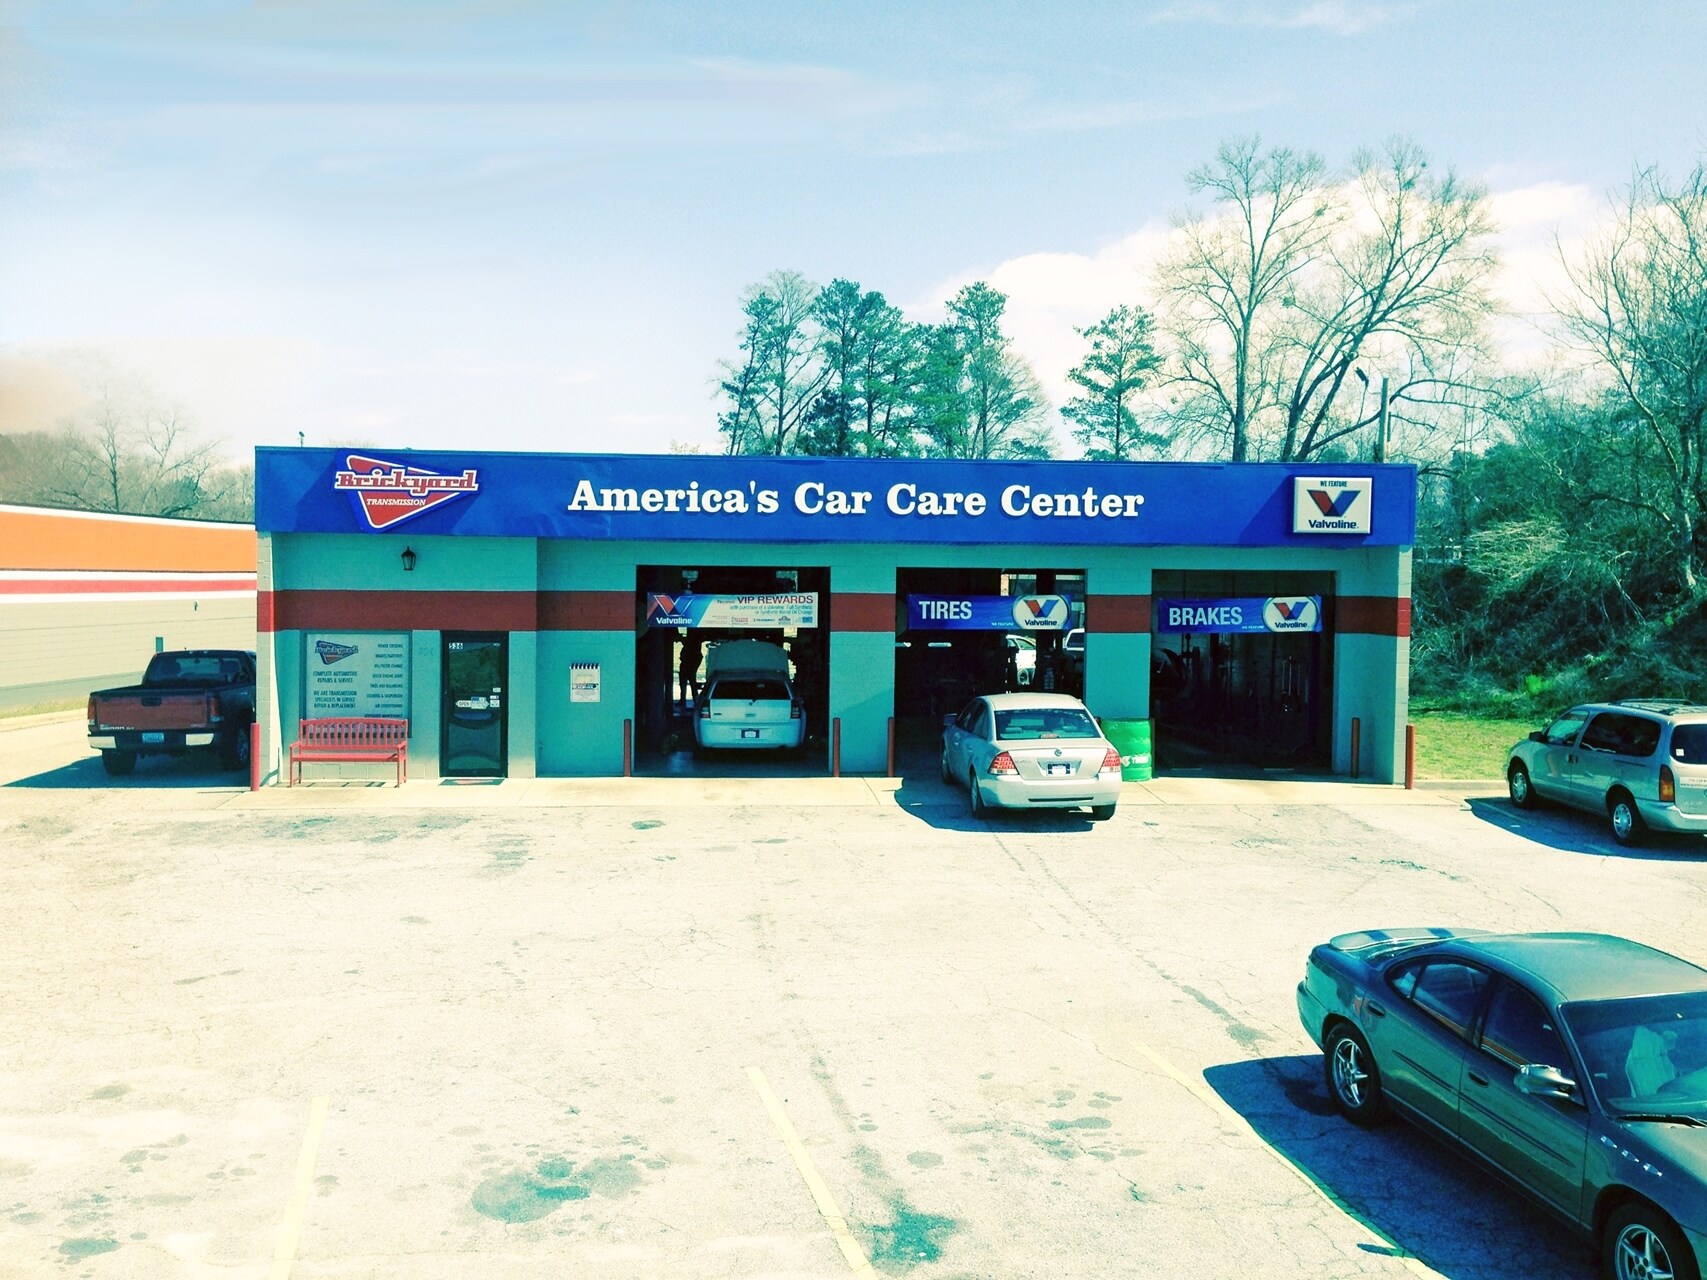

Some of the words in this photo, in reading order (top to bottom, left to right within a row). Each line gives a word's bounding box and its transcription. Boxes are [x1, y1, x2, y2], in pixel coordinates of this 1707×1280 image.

[335, 469, 479, 496] Brickyard
[366, 498, 426, 506] TRANSMISSION
[567, 479, 780, 514] America's
[794, 482, 873, 515] Car
[886, 483, 987, 516] Care
[1001, 485, 1145, 518] Center
[1308, 519, 1357, 529] Valvoline
[737, 596, 755, 604] VIP
[757, 595, 814, 604] REWARDS
[919, 601, 972, 620] TIRES
[1169, 607, 1243, 626] BRAKES
[656, 617, 693, 625] Valvoline
